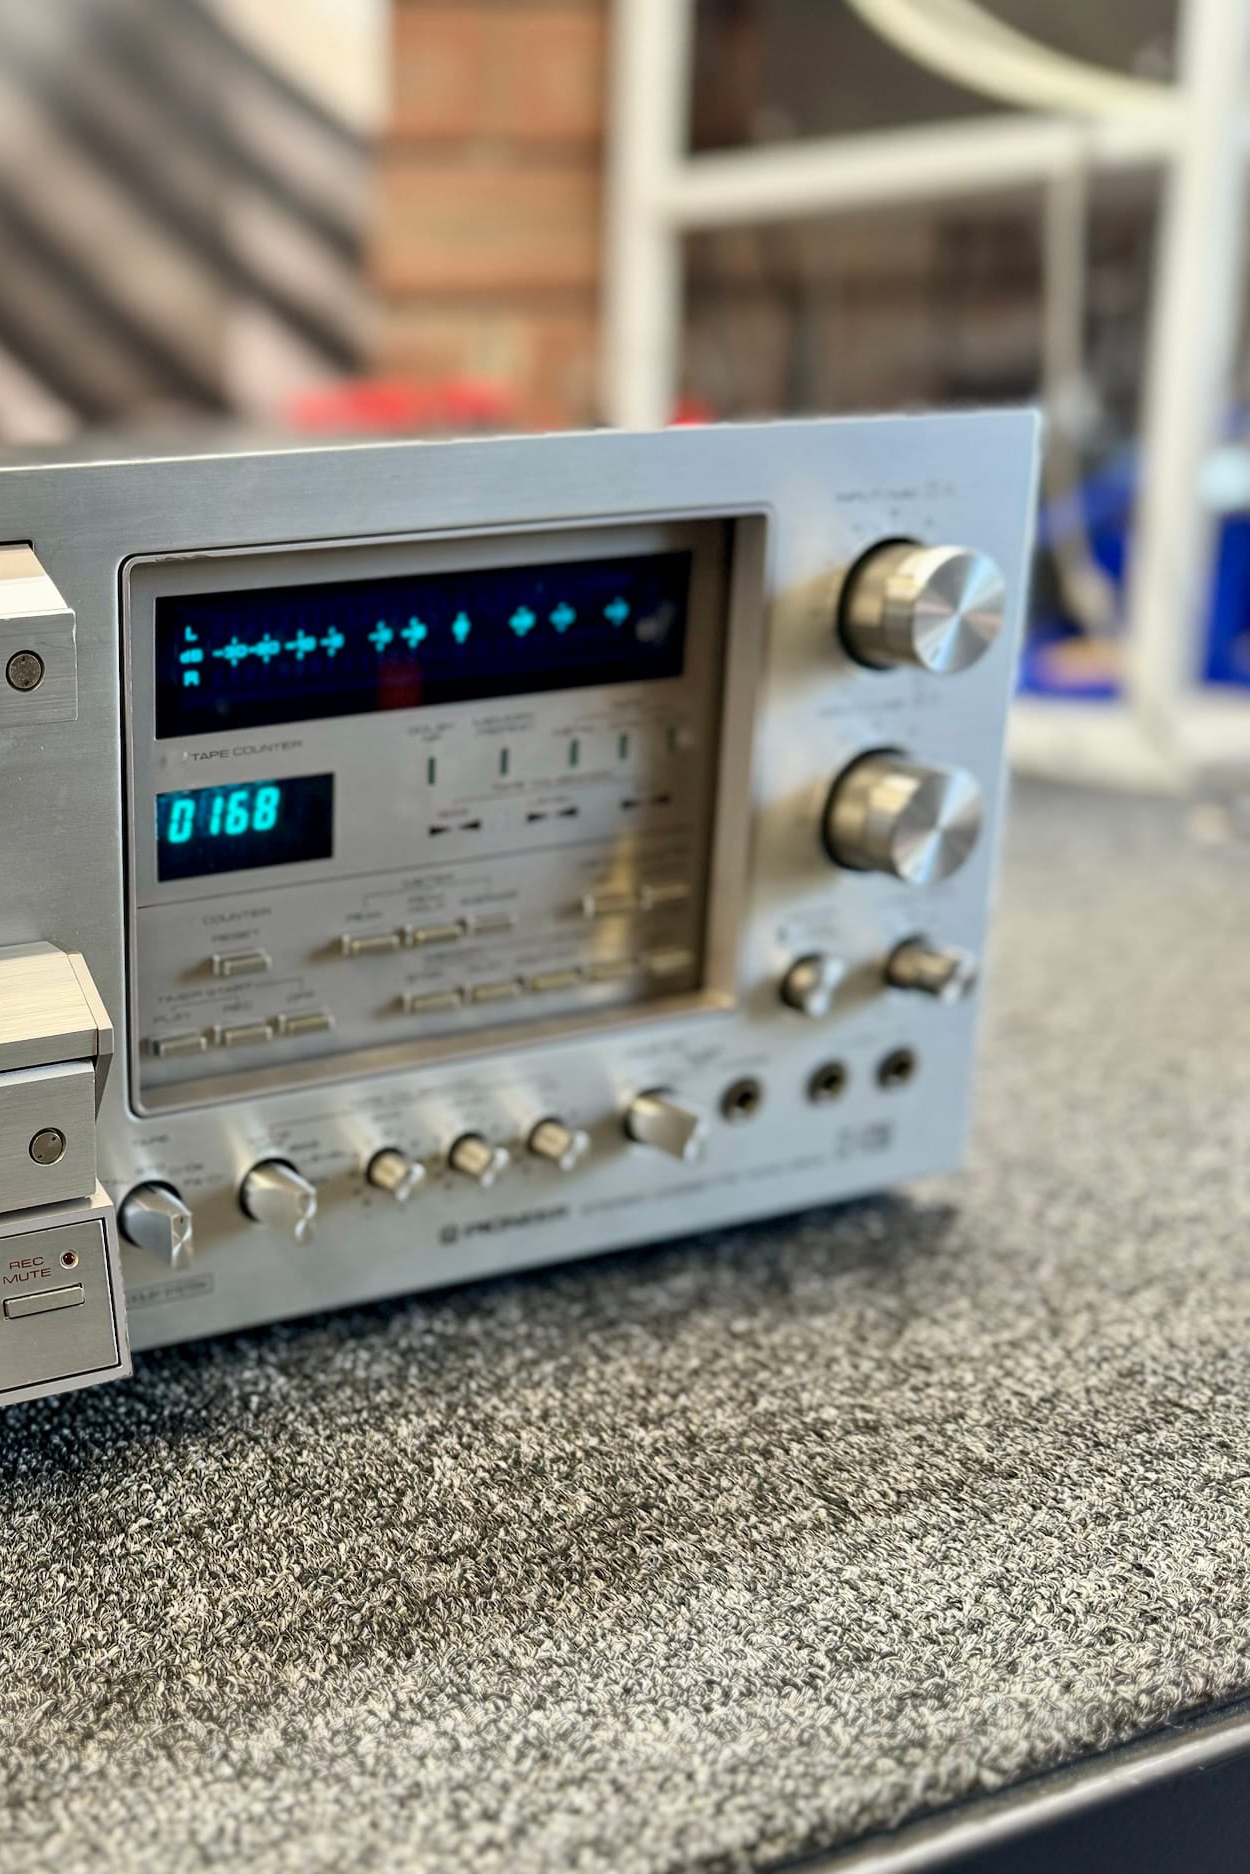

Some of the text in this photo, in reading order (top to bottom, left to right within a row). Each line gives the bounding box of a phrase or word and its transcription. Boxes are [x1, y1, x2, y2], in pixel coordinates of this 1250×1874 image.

[190, 740, 303, 762] TAPE COUNTER
[167, 785, 281, 845] 0168
[9, 1256, 45, 1270] REC
[2, 1267, 52, 1285] MUTE
